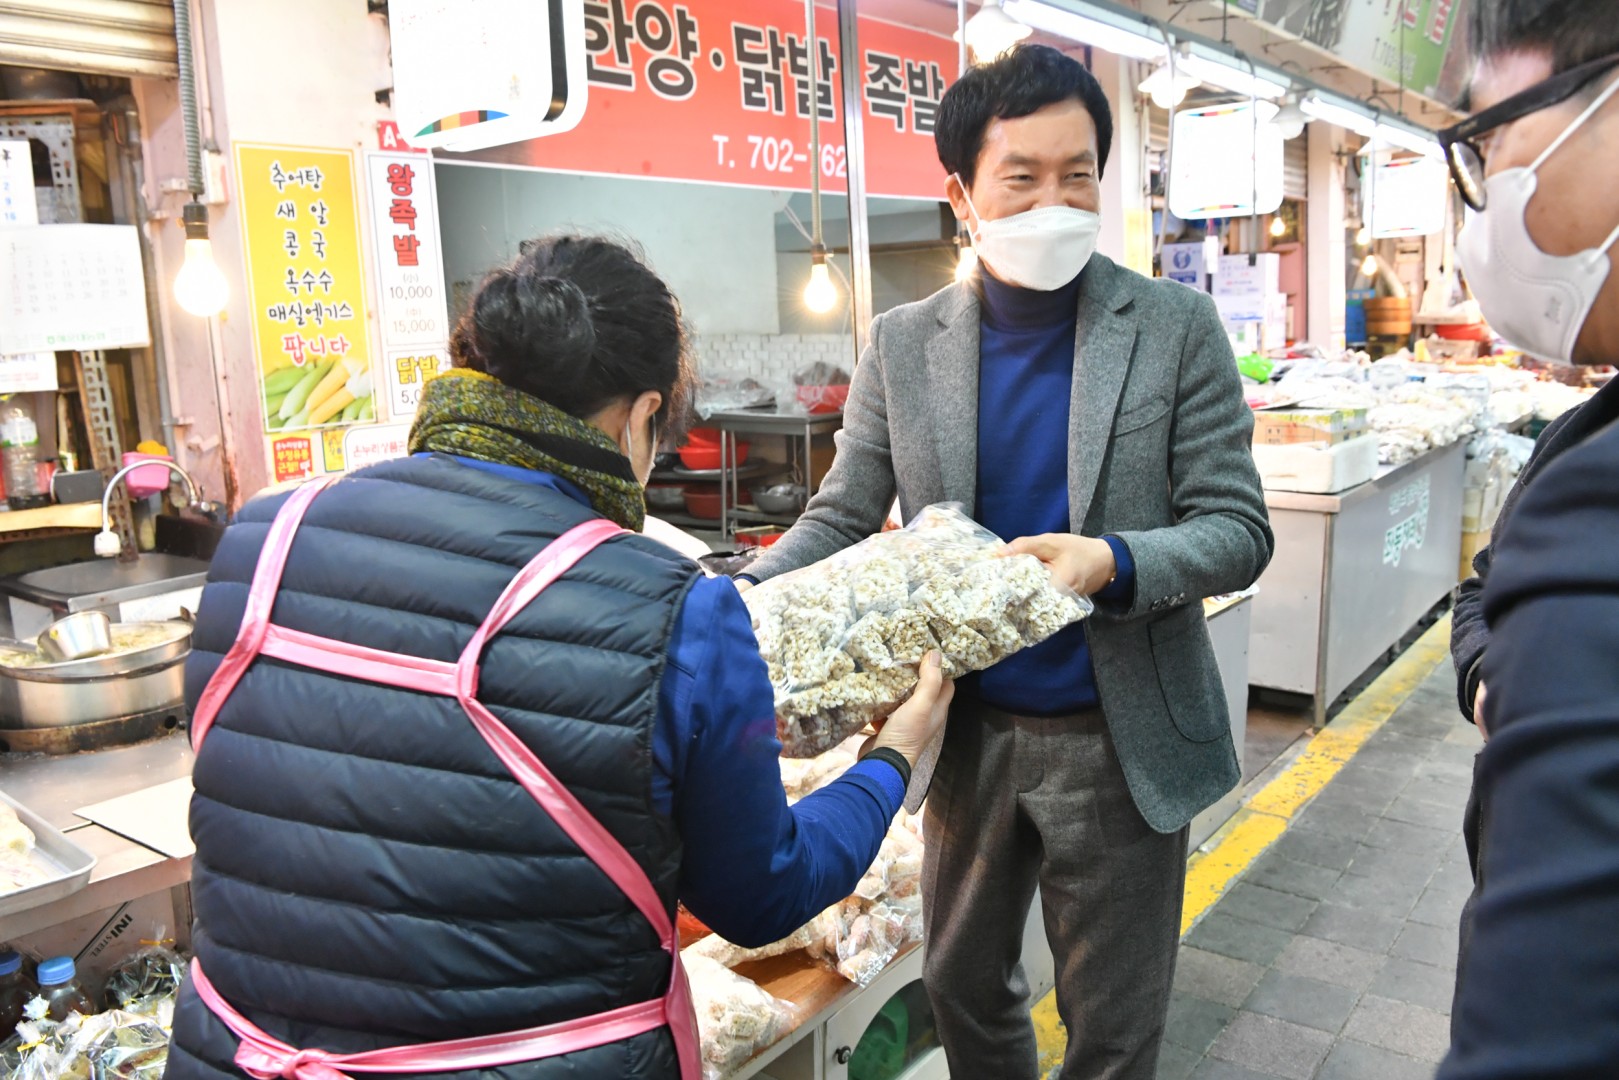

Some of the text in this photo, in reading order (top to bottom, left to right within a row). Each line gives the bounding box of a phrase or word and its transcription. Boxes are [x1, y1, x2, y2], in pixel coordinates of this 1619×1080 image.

[864, 48, 945, 135] 족발
[272, 163, 322, 190] 추어탕
[387, 163, 421, 266] 왕족발
[285, 268, 333, 295] 옥수수
[390, 285, 433, 301] 10,000
[268, 301, 353, 327] 매실엑기스
[393, 319, 435, 335] 15,000
[283, 333, 350, 365] 팝니다
[396, 354, 440, 385] 닭발
[111, 913, 133, 938] INI
[90, 935, 112, 957] STEEL
